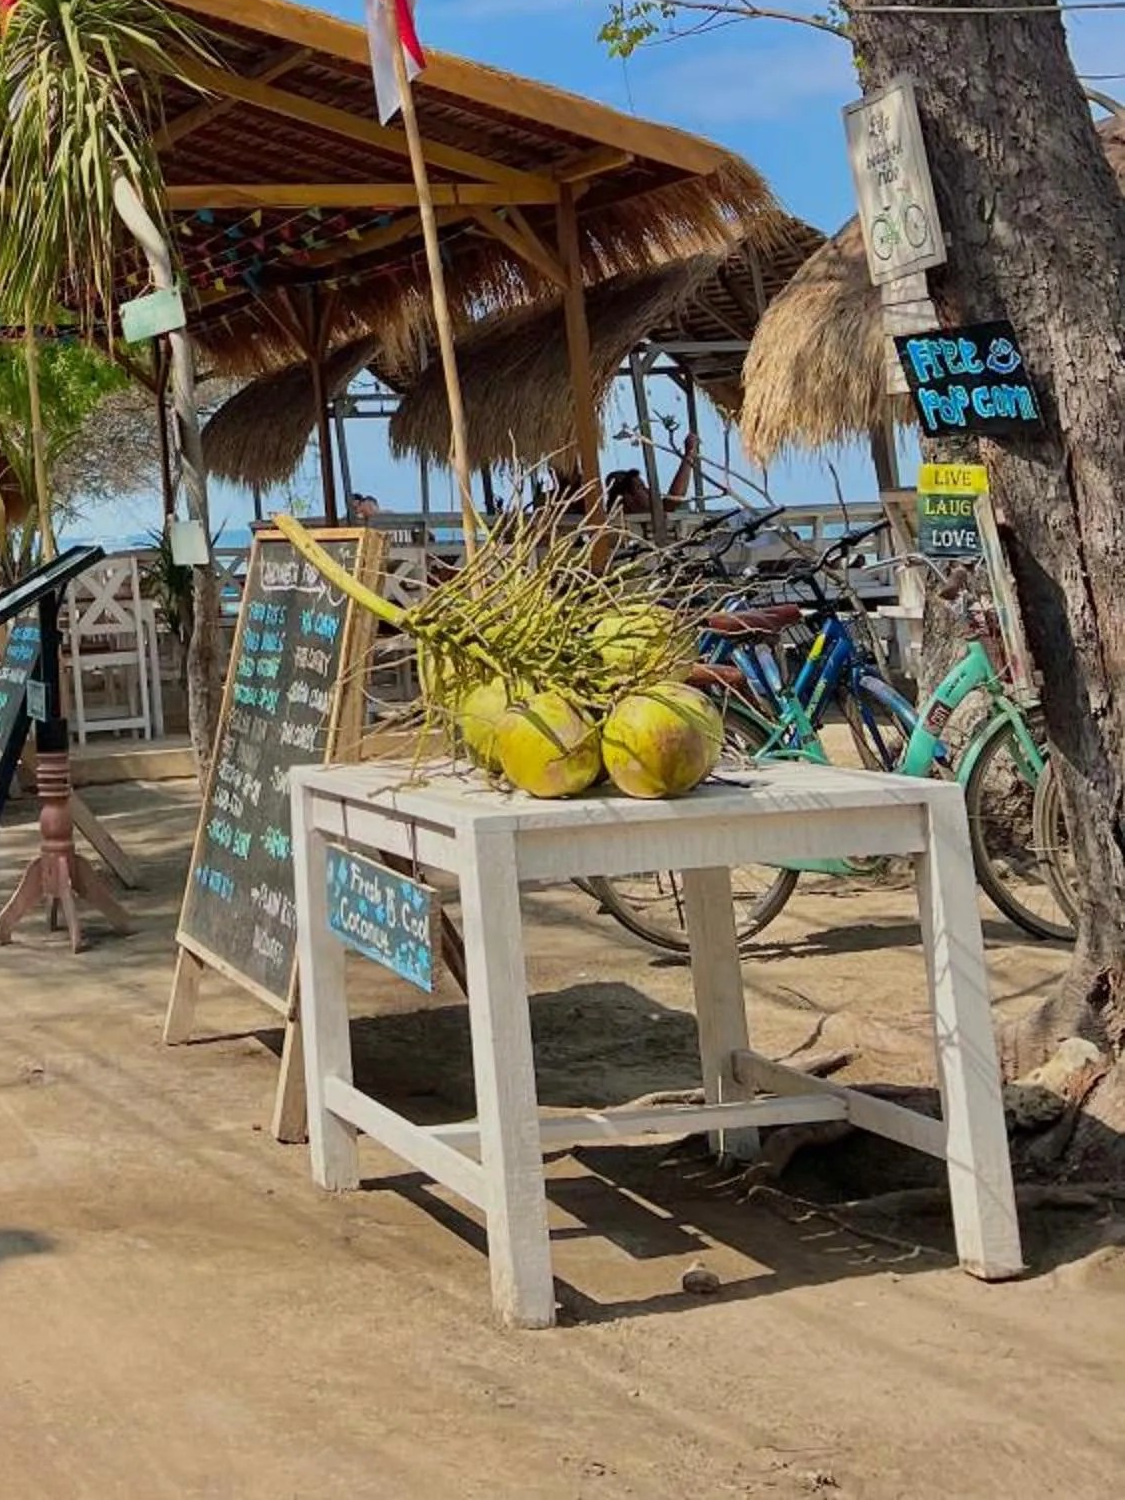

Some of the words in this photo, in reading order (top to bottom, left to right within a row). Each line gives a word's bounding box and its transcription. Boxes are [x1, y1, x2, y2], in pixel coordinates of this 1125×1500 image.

[933, 468, 972, 487] LIVE
[924, 497, 973, 517] LAUG
[931, 528, 978, 550] LOVE
